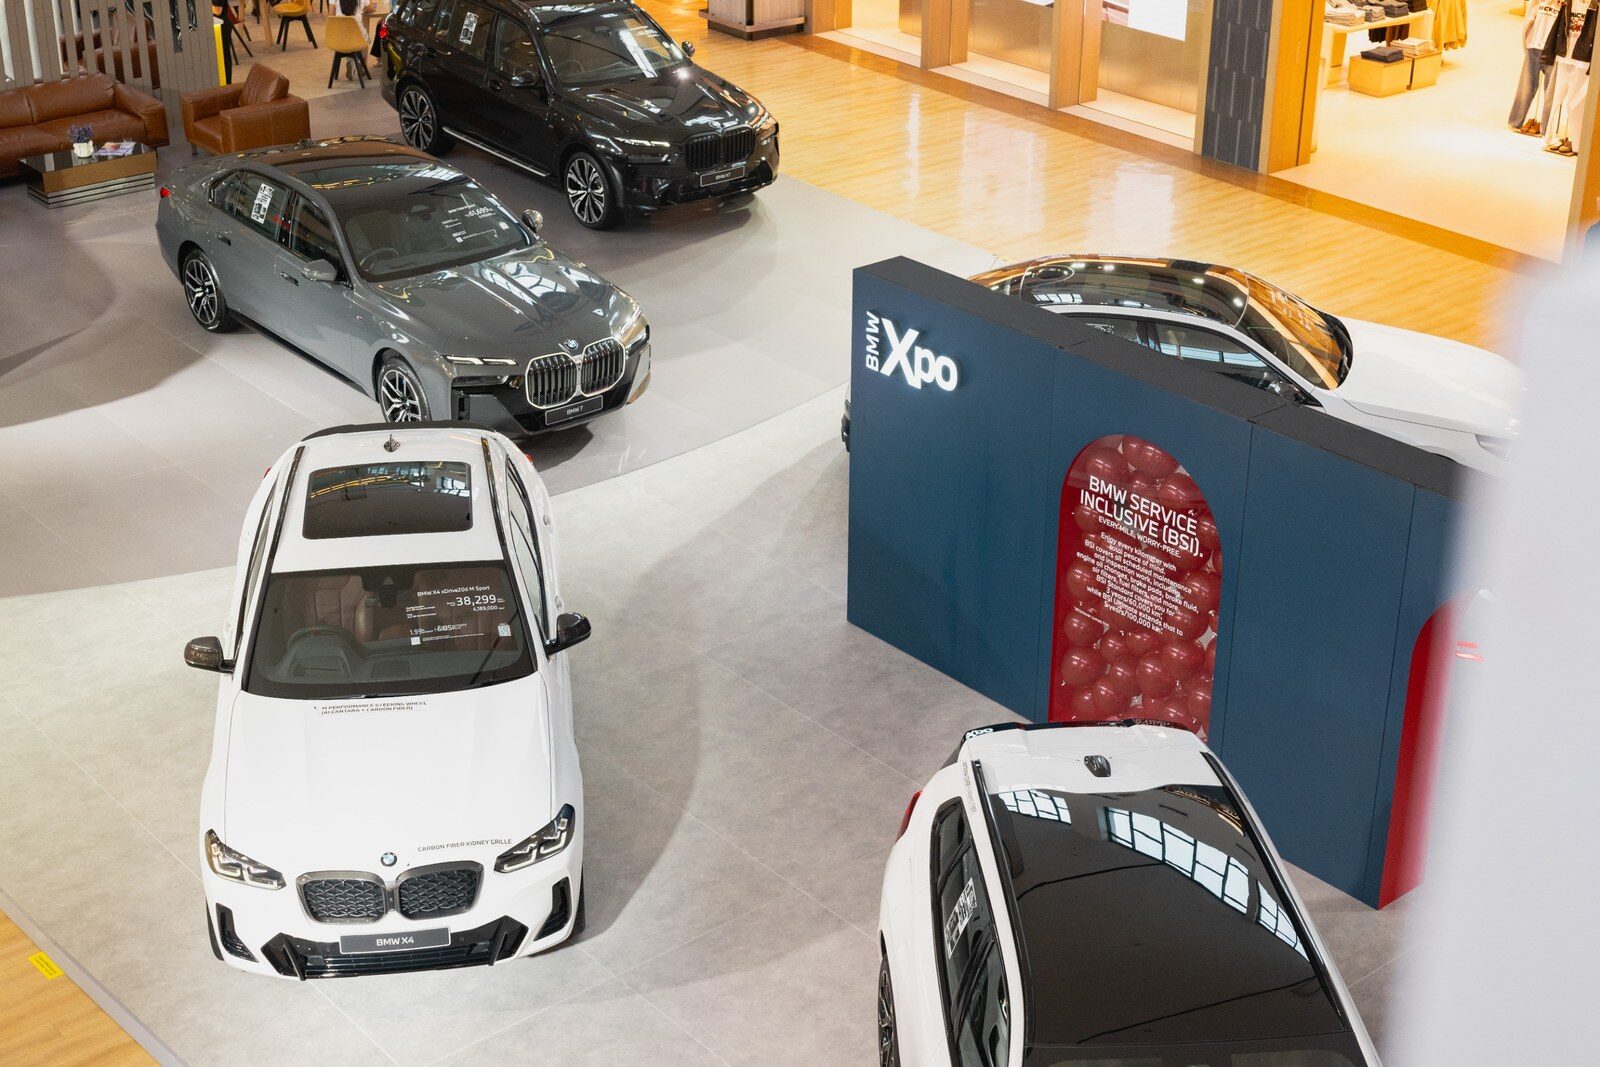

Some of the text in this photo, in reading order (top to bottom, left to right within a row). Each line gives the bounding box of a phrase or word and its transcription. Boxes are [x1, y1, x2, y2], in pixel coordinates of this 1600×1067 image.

[865, 310, 880, 372] BMW
[880, 317, 958, 391] Xpo
[1080, 489, 1203, 558] INCLUSIVE (BSI).
[1089, 475, 1197, 536] BMW SERVICE
[1084, 538, 1094, 549] BSI
[1095, 545, 1113, 557] covers
[1122, 557, 1152, 575] scheduled
[1153, 572, 1192, 594] maintenance
[1094, 551, 1104, 561] and
[1105, 557, 1134, 576] inspection
[1117, 540, 1133, 553] every
[1162, 559, 1176, 572] with
[1123, 550, 1140, 564] peace
[1142, 557, 1148, 567] of
[1076, 550, 1095, 565] engine
[1130, 576, 1146, 589] brake
[1164, 592, 1182, 606] brake
[1092, 564, 1100, 574] air
[1119, 577, 1129, 589] fuel
[1150, 593, 1161, 604] and
[1096, 573, 1174, 617] BSI Standard covers you for
[1106, 586, 1110, 594] 3
[455, 594, 496, 606] 38,299
[1086, 584, 1101, 597] while
[1102, 591, 1112, 603] BSI
[1138, 609, 1161, 626] extends
[1162, 621, 1175, 633] that
[1176, 628, 1183, 636] to
[417, 844, 445, 852] CARBON
[376, 936, 414, 946] BMW X4
